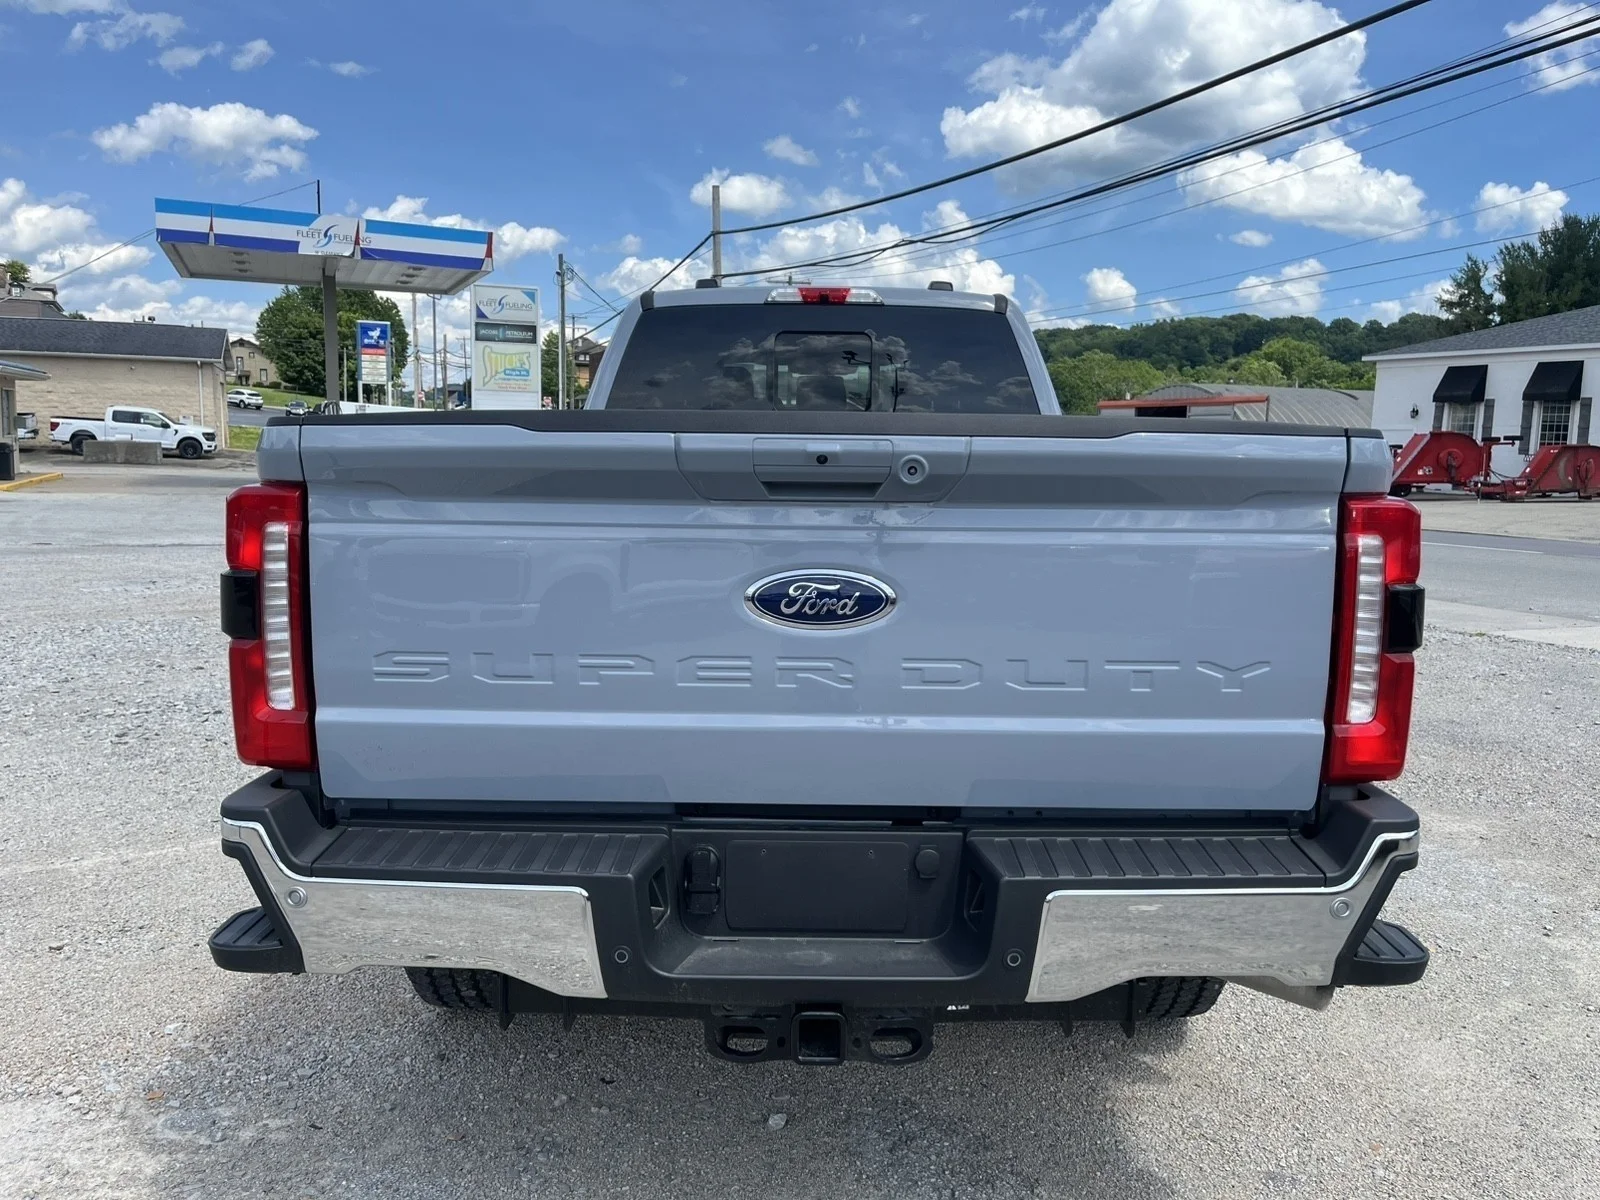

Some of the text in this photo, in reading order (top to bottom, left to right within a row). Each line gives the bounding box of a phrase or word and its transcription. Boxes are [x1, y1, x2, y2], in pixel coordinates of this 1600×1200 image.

[296, 229, 372, 244] FLEET FUELNG
[505, 302, 533, 310] FUELING
[780, 582, 861, 615] Ford
[373, 651, 1271, 692] SUPER DUTY
